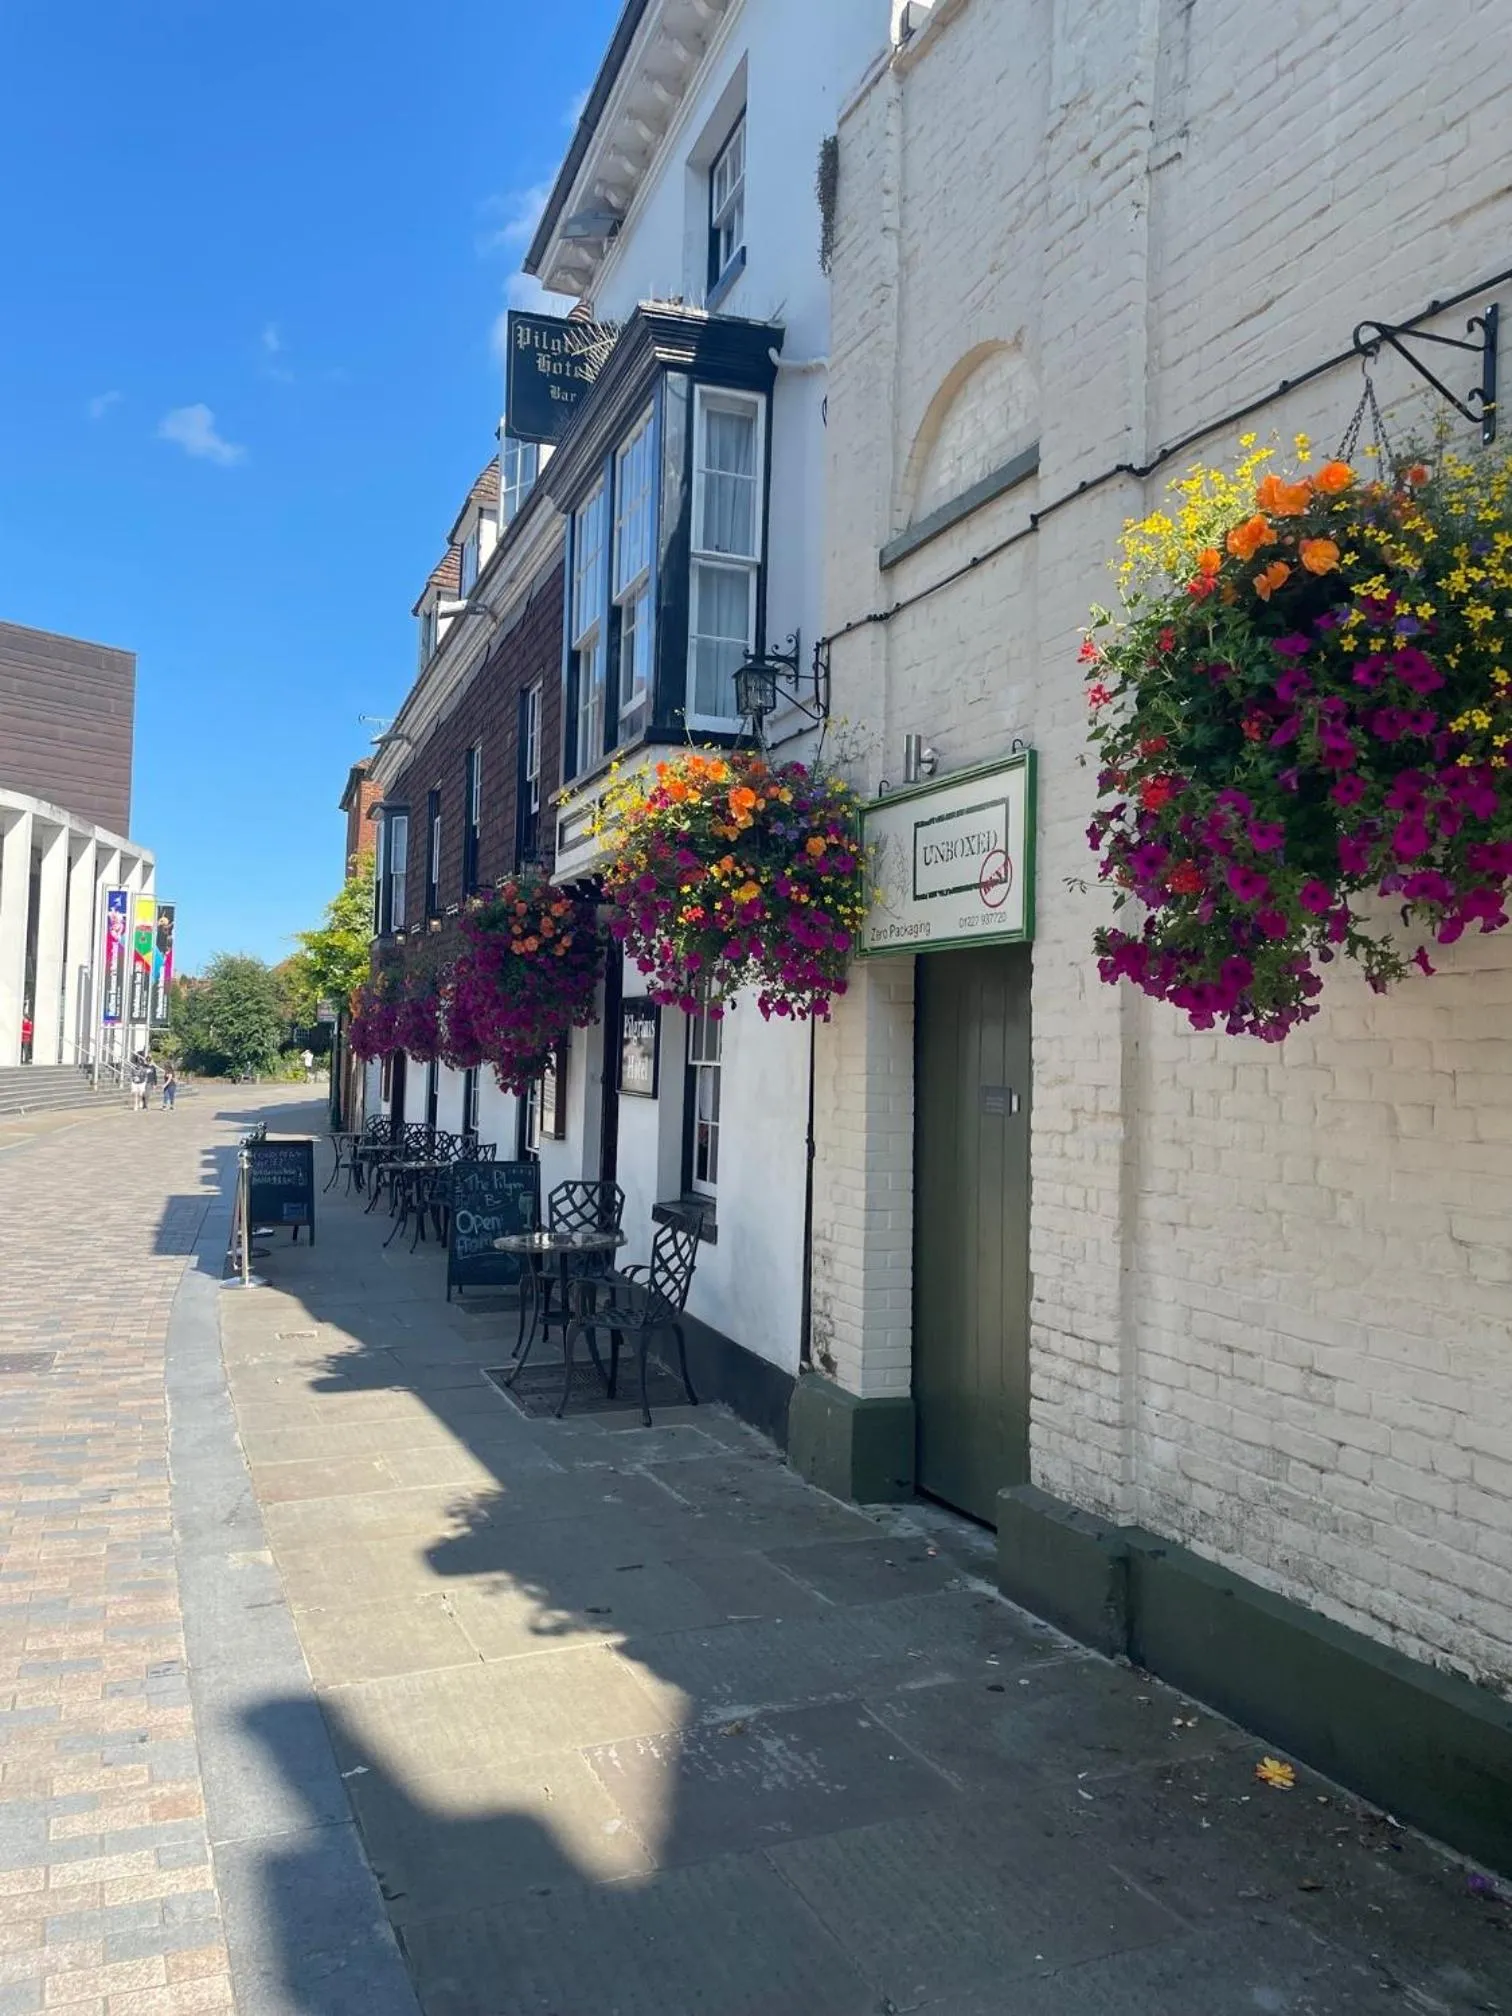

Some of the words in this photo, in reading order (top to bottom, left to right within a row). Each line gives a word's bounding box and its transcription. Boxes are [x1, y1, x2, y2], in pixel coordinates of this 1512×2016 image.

[550, 384, 578, 402] Bar
[923, 830, 997, 866] UNBOXED
[870, 926, 889, 942] Zero
[889, 922, 932, 938] Packaging
[623, 1013, 656, 1046] Pilgrims
[627, 1055, 649, 1081] Hotel
[456, 1210, 502, 1234] Open
